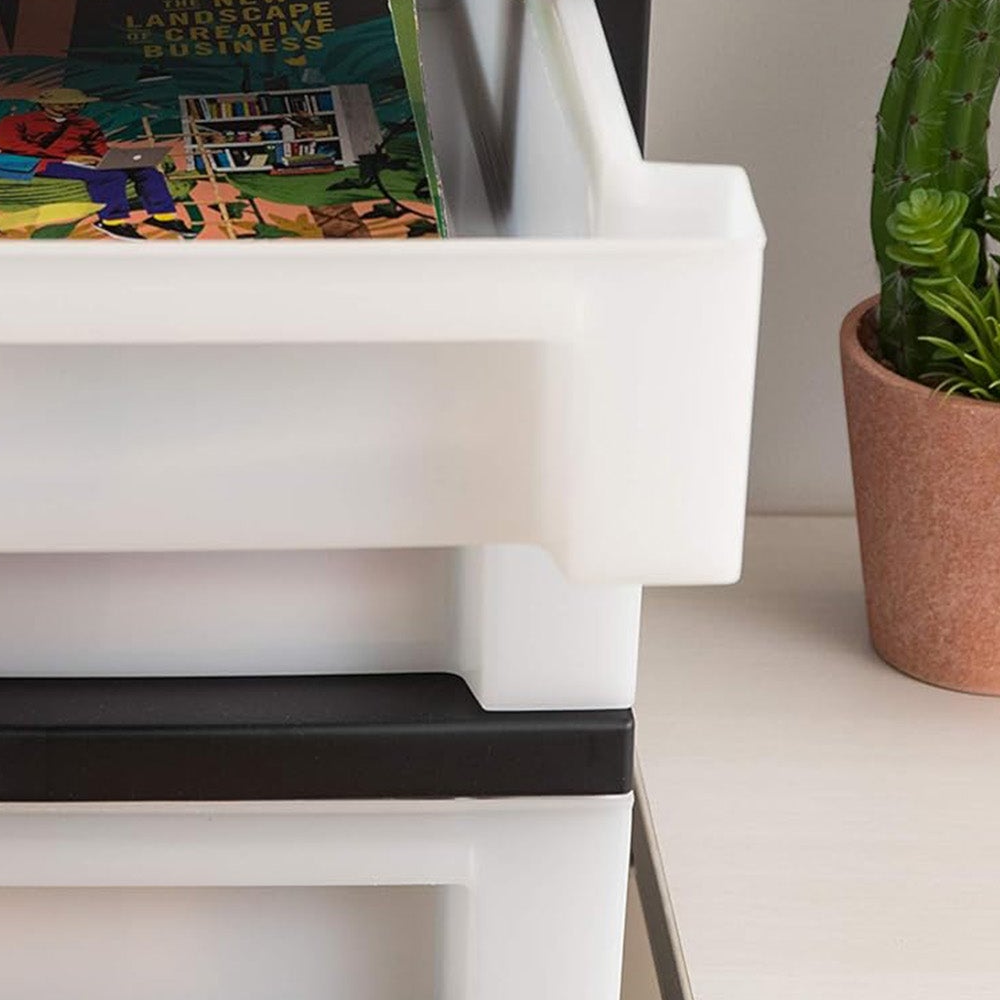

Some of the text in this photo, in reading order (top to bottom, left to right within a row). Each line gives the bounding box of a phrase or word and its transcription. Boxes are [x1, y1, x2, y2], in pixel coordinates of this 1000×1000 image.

[124, 0, 334, 29] LANDSCAPE
[165, 18, 337, 42] CREATIVE
[142, 35, 325, 59] BUSINESS
